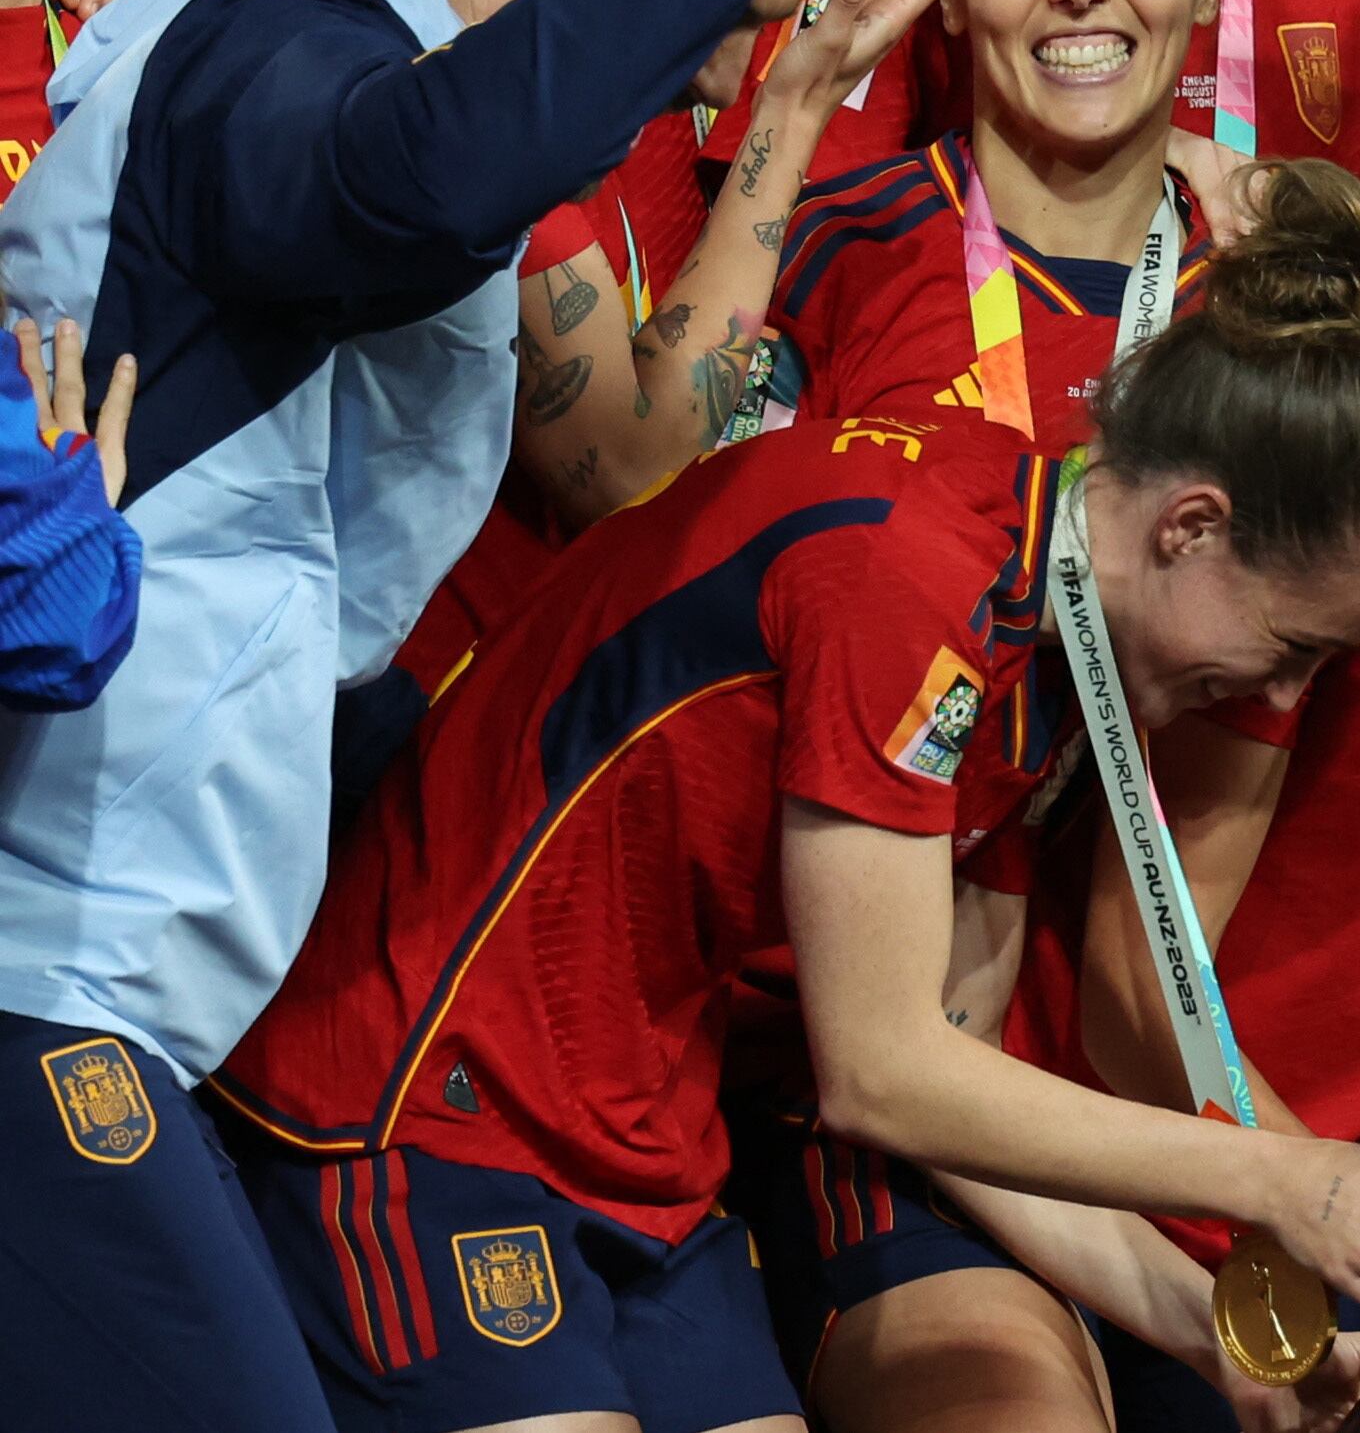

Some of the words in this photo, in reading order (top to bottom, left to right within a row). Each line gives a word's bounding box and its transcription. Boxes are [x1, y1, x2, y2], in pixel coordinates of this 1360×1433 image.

[1182, 75, 1216, 86] ENGLAN
[1182, 86, 1215, 97] AUGUST
[1189, 98, 1216, 108] SYDNE
[1144, 233, 1162, 272] FIFA
[1067, 386, 1080, 398] 20
[1058, 556, 1084, 608] FIFA
[1072, 607, 1116, 721] WOMEN'S
[1104, 724, 1139, 809] WORLD
[1129, 812, 1154, 859] CUP
